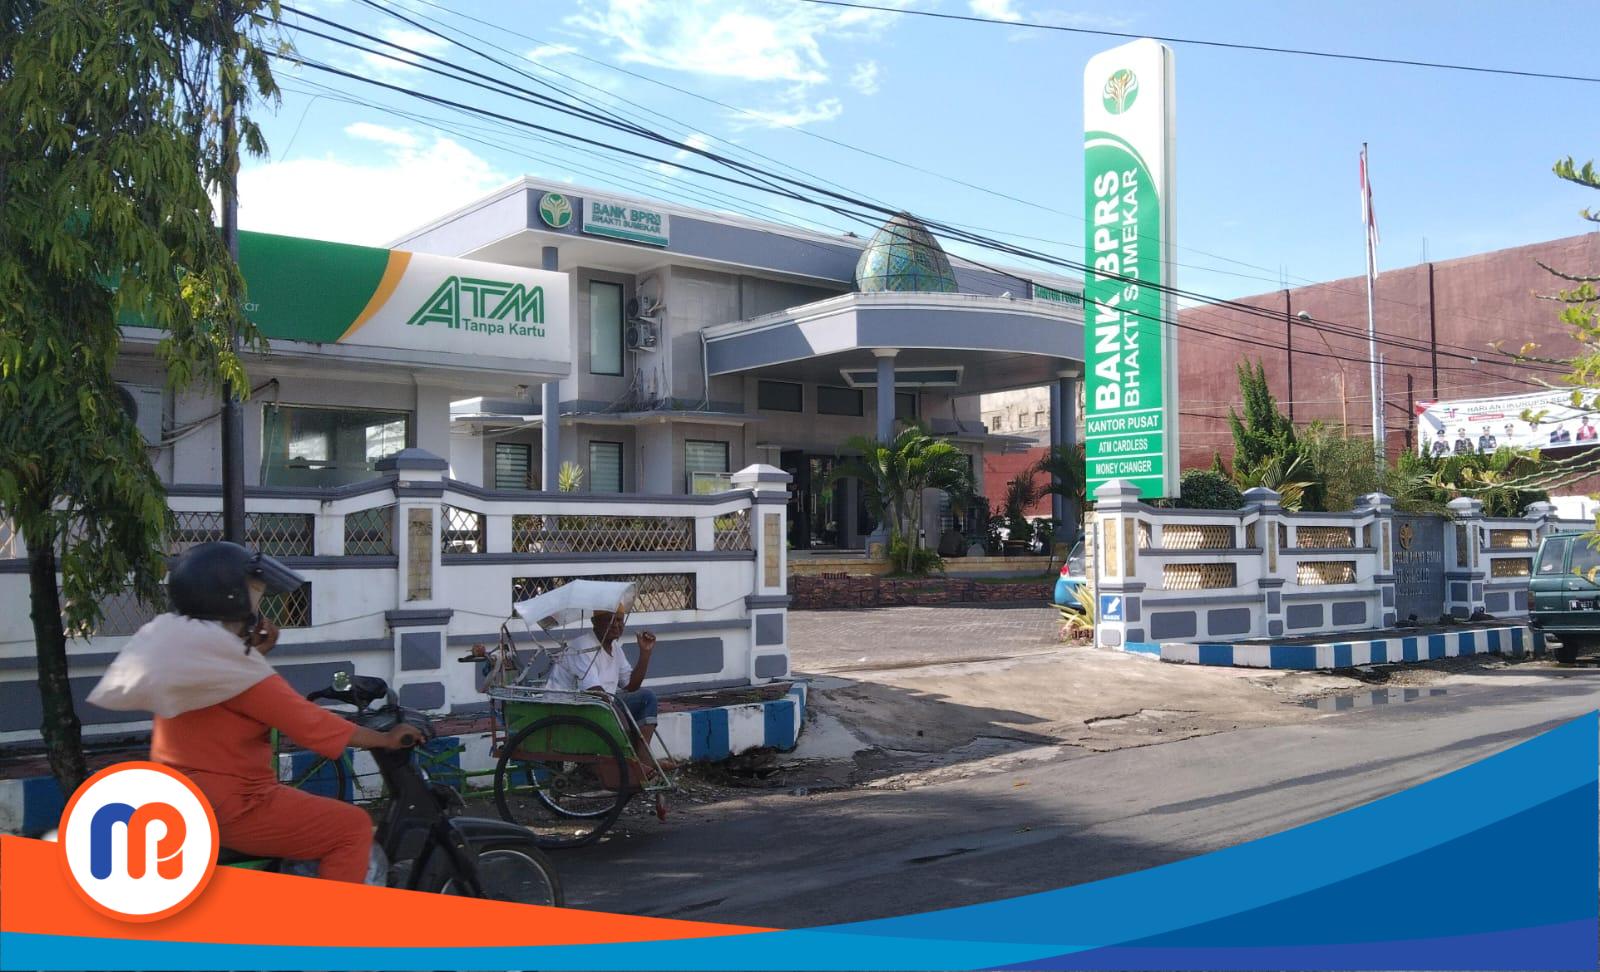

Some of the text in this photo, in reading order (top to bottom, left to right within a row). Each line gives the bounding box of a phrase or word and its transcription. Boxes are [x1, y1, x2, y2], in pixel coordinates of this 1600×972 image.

[591, 202, 662, 226] BANK BPRS
[1094, 170, 1121, 410] BANK BPRS
[1122, 167, 1140, 407] BHAKTI SUMEKAR
[406, 275, 545, 328] ATM
[461, 318, 545, 338] Tanpa Kartu
[1088, 415, 1159, 432] KANTOR PUSAT
[1098, 438, 1148, 453] ATM CARDLESS
[1096, 460, 1152, 475] MONEY CHANGER
